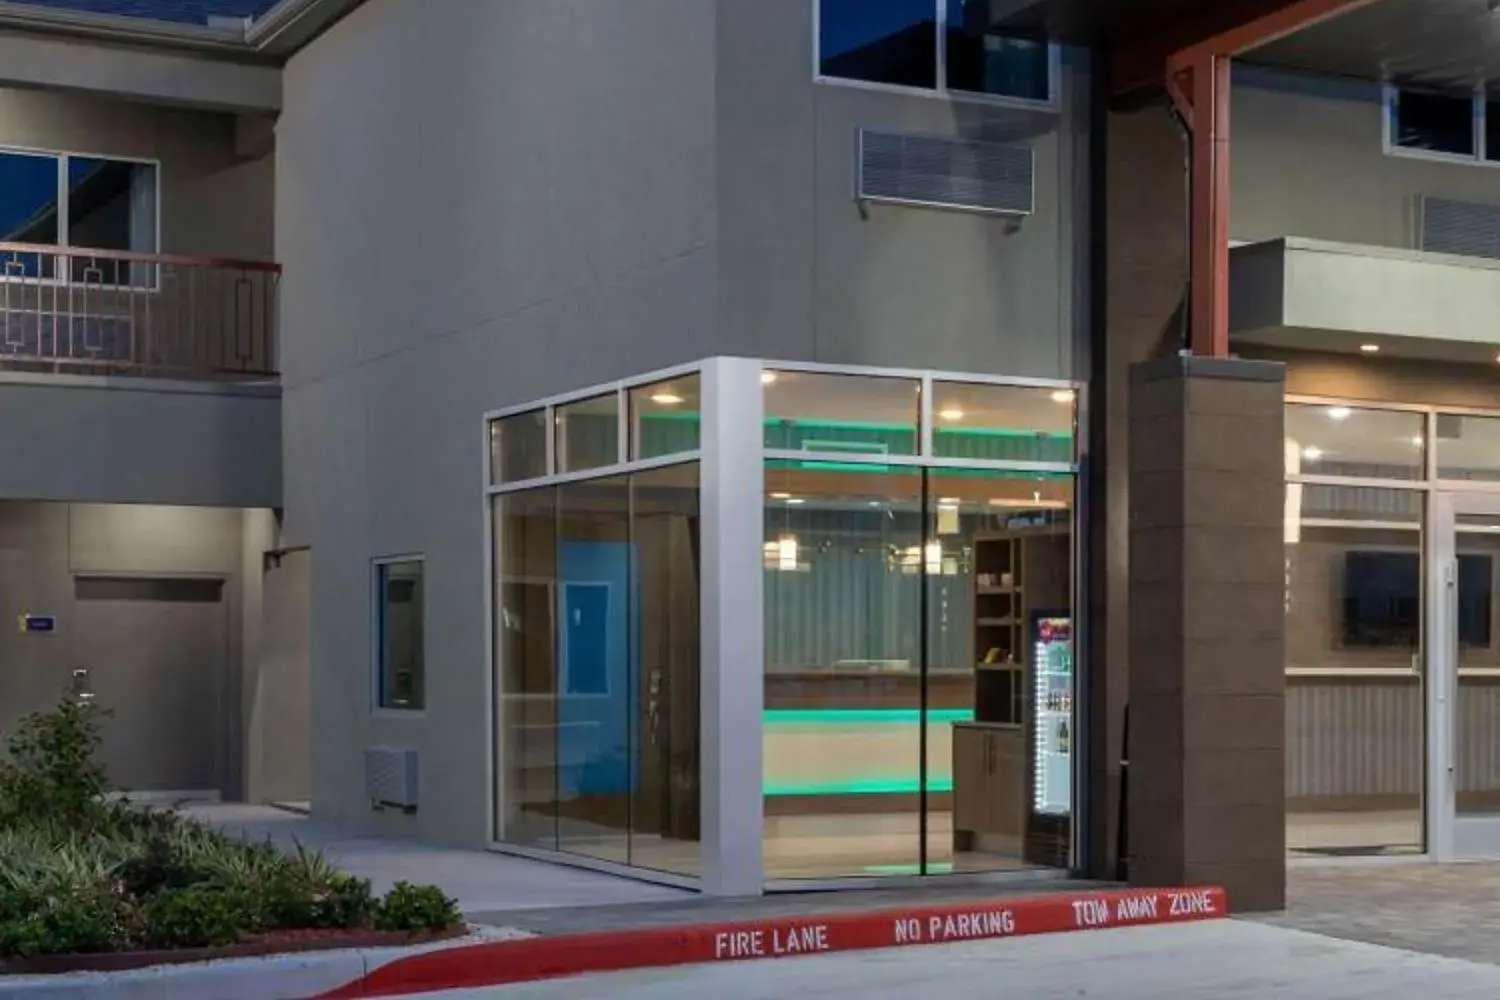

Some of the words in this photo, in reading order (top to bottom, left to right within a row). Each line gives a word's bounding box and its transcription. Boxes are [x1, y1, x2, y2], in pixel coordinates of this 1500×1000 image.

[1072, 900, 1109, 926] TOW
[1116, 894, 1158, 921] AWAY
[1168, 889, 1216, 914] ZONE
[715, 931, 765, 958] FIRE
[772, 924, 829, 953] LANE
[895, 918, 921, 942] NO
[929, 909, 1015, 940] PARKING
